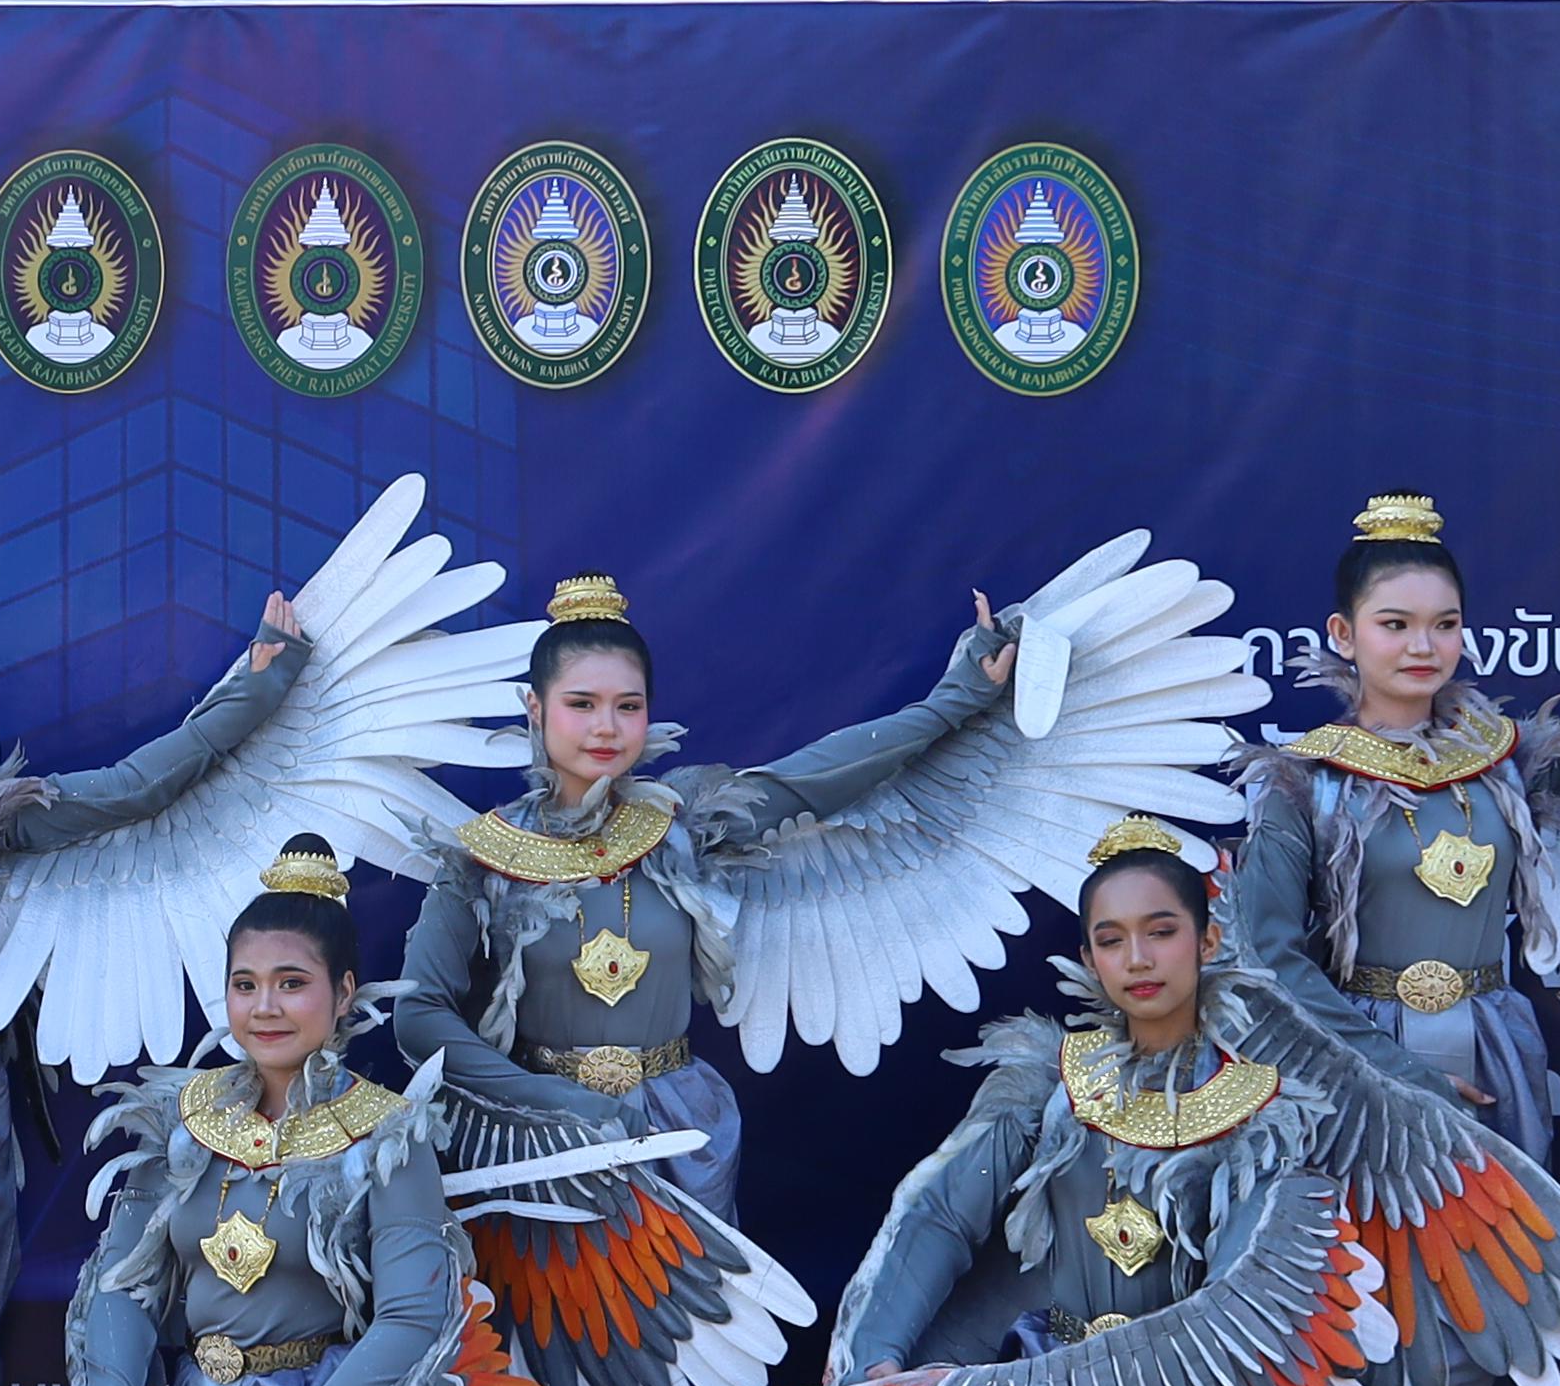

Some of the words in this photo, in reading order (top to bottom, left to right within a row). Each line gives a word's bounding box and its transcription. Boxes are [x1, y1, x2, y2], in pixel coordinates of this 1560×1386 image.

[31, 363, 102, 385] RAJABHAT
[106, 294, 153, 370] UNIVERSITY
[234, 266, 272, 358] KAMPHAENG
[269, 356, 305, 387] PHET
[308, 356, 383, 393] RAJABHAT
[381, 271, 417, 357] UNIVERSITY
[474, 292, 500, 348] NAKHON
[499, 344, 532, 373] SAWAN
[539, 357, 591, 380] RAJABHAT
[594, 293, 636, 362] UNIVERSITY
[704, 267, 754, 366] PHETCHABUN
[758, 357, 842, 385] RAJABHAT
[845, 270, 885, 355] UNIVERSITY
[951, 277, 1017, 381] PIBULSONGKRAM
[1020, 359, 1090, 389] RAJABHAT
[1090, 278, 1128, 358] UNIVERSITY
